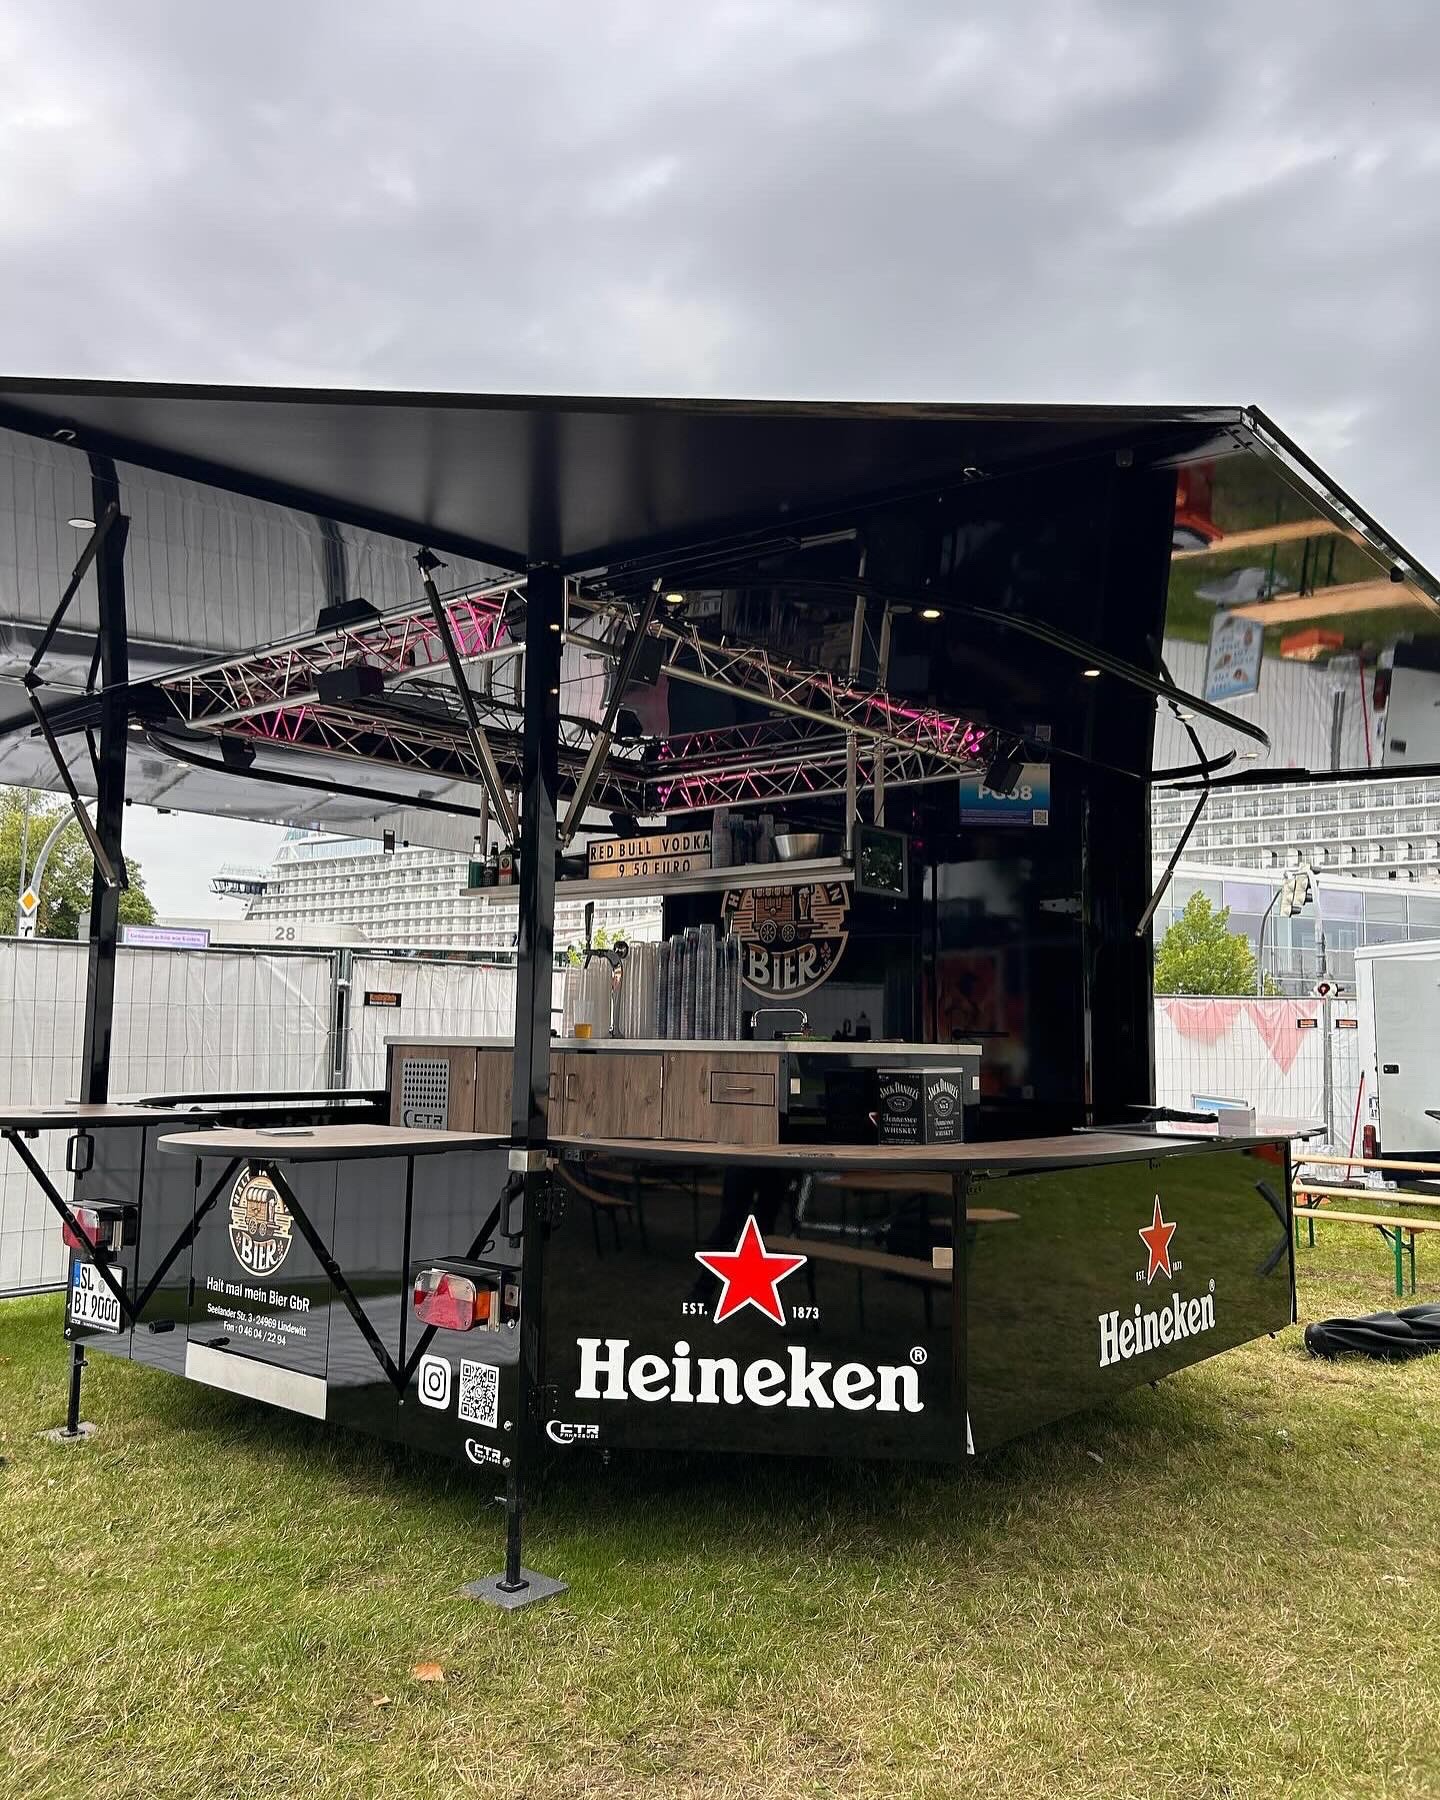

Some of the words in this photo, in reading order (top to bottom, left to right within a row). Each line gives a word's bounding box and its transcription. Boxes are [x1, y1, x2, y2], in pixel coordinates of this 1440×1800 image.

[590, 845, 614, 861] RED
[620, 841, 651, 857] BULL
[662, 834, 710, 852] VODKA
[654, 860, 690, 874] EURO
[275, 926, 296, 941] 28
[747, 943, 822, 991] BIER
[879, 1084, 895, 1099] JACK
[927, 1082, 940, 1101] JACK
[414, 1113, 444, 1124] CTR
[884, 1127, 918, 1135] WHISKEY
[233, 1171, 251, 1205] HALT
[240, 1231, 278, 1269] BIER
[81, 1266, 94, 1290] SL
[206, 1275, 224, 1293] Halt
[225, 1283, 243, 1297] mal
[244, 1287, 267, 1303] mein
[268, 1289, 288, 1307] Bier
[289, 1294, 310, 1313] GbR
[74, 1291, 88, 1316] BI
[91, 1294, 119, 1322] 9000
[682, 1302, 708, 1315] EST.
[792, 1305, 820, 1319] 1873
[207, 1303, 236, 1319] Seelander
[236, 1309, 247, 1322] Str.
[247, 1312, 253, 1323] 3
[255, 1314, 277, 1329] 24969
[277, 1320, 307, 1337] Lindewitt
[223, 1320, 235, 1332] Fon
[267, 1332, 277, 1343] 22
[277, 1334, 286, 1346] 94
[560, 1423, 600, 1434] CTR
[474, 1443, 501, 1460] CTR
